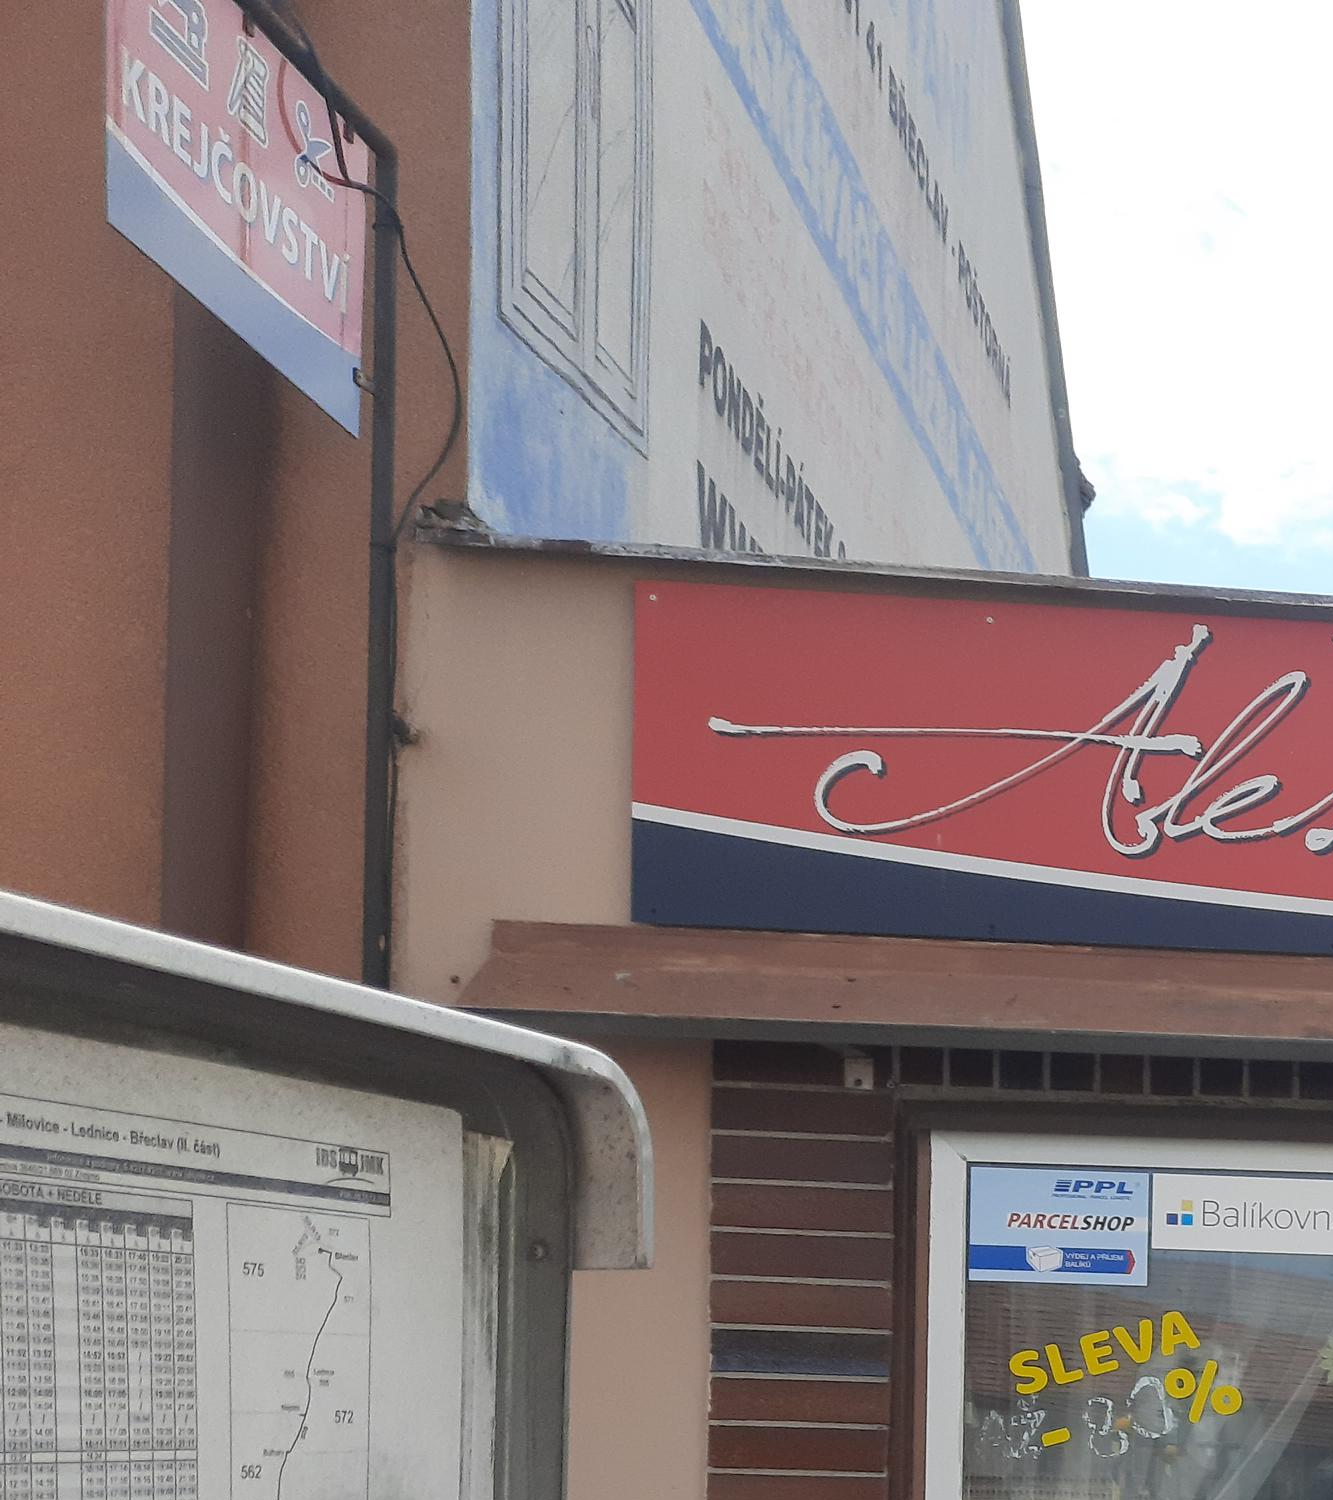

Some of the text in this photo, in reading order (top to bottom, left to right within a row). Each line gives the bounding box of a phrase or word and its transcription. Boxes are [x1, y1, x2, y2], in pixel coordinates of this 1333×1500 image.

[888, 66, 949, 242] BŘECLAV
[121, 46, 351, 316] KREJČOVSTVÍ
[7, 1112, 60, 1134] Milovice
[71, 1122, 120, 1145] Lednice
[130, 1130, 174, 1151] Břeclav
[0, 1182, 44, 1199] OBOTA
[1072, 1179, 1134, 1195] PPL
[1007, 1212, 1135, 1232] PARCELSHOP
[243, 1262, 264, 1278] 575
[1008, 1310, 1200, 1396] SLEVA
[335, 1410, 353, 1424] 572
[241, 1465, 261, 1479] 562
